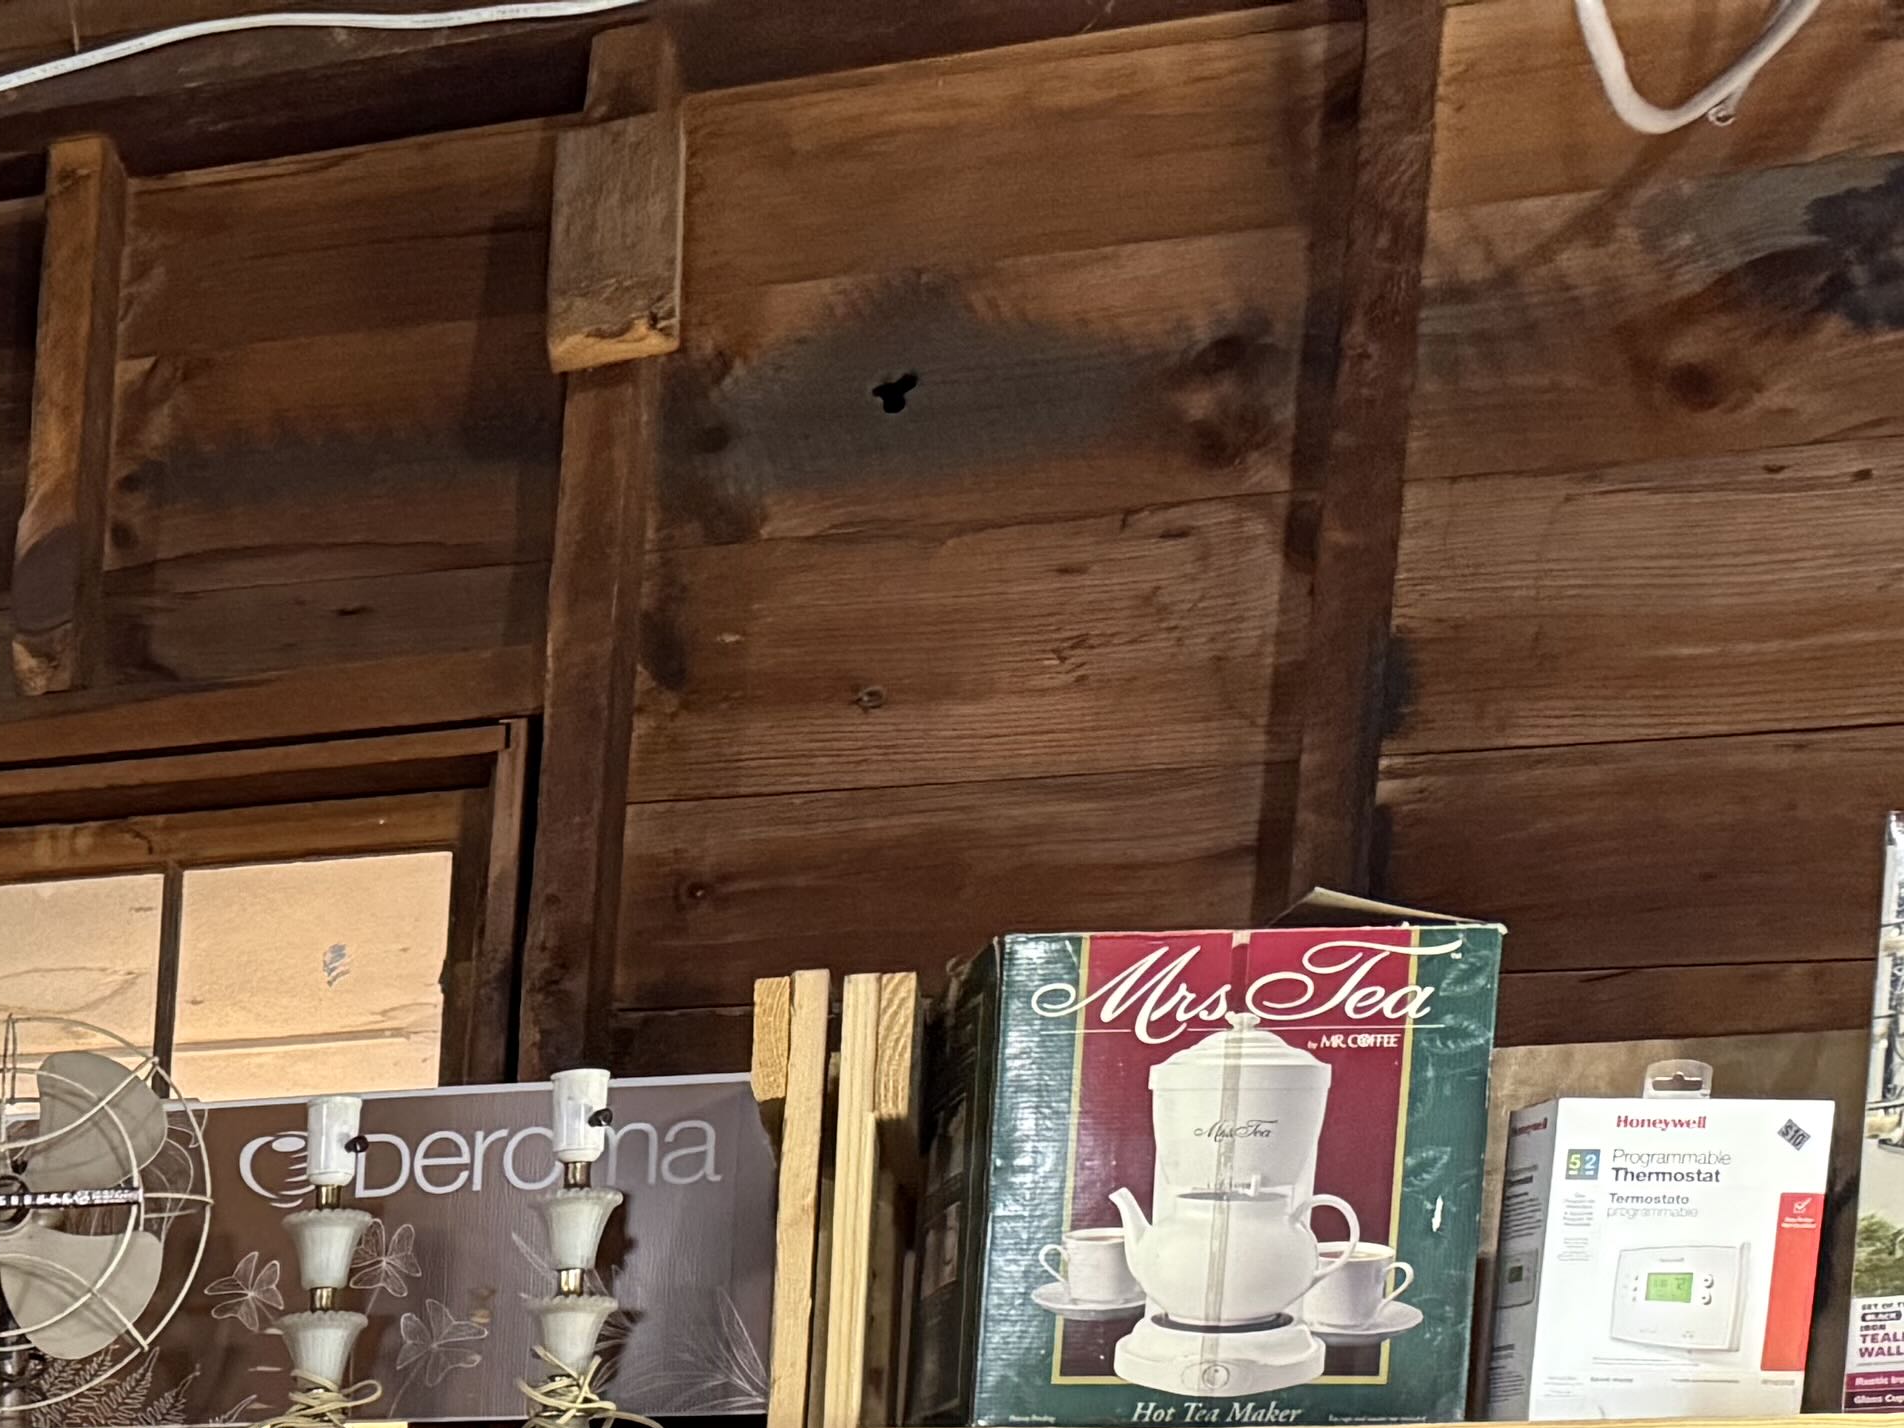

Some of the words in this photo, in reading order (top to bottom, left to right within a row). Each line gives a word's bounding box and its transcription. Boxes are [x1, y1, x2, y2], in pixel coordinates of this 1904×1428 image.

[1032, 945, 1241, 1044] Mrs.
[1245, 939, 1462, 1020] Tea
[1348, 1034, 1400, 1048] COFFEE
[1616, 1115, 1706, 1131] Honeywell
[1569, 1153, 1581, 1170] 5
[1584, 1153, 1596, 1170] 2
[1612, 1148, 1731, 1167] Programmable
[1612, 1167, 1720, 1183] Thermostat
[1609, 1192, 1689, 1205] Termostato
[1607, 1206, 1698, 1219] programmable
[1133, 1401, 1171, 1422] Hot
[1184, 1401, 1219, 1422] Tea
[1227, 1401, 1301, 1423] Maker
